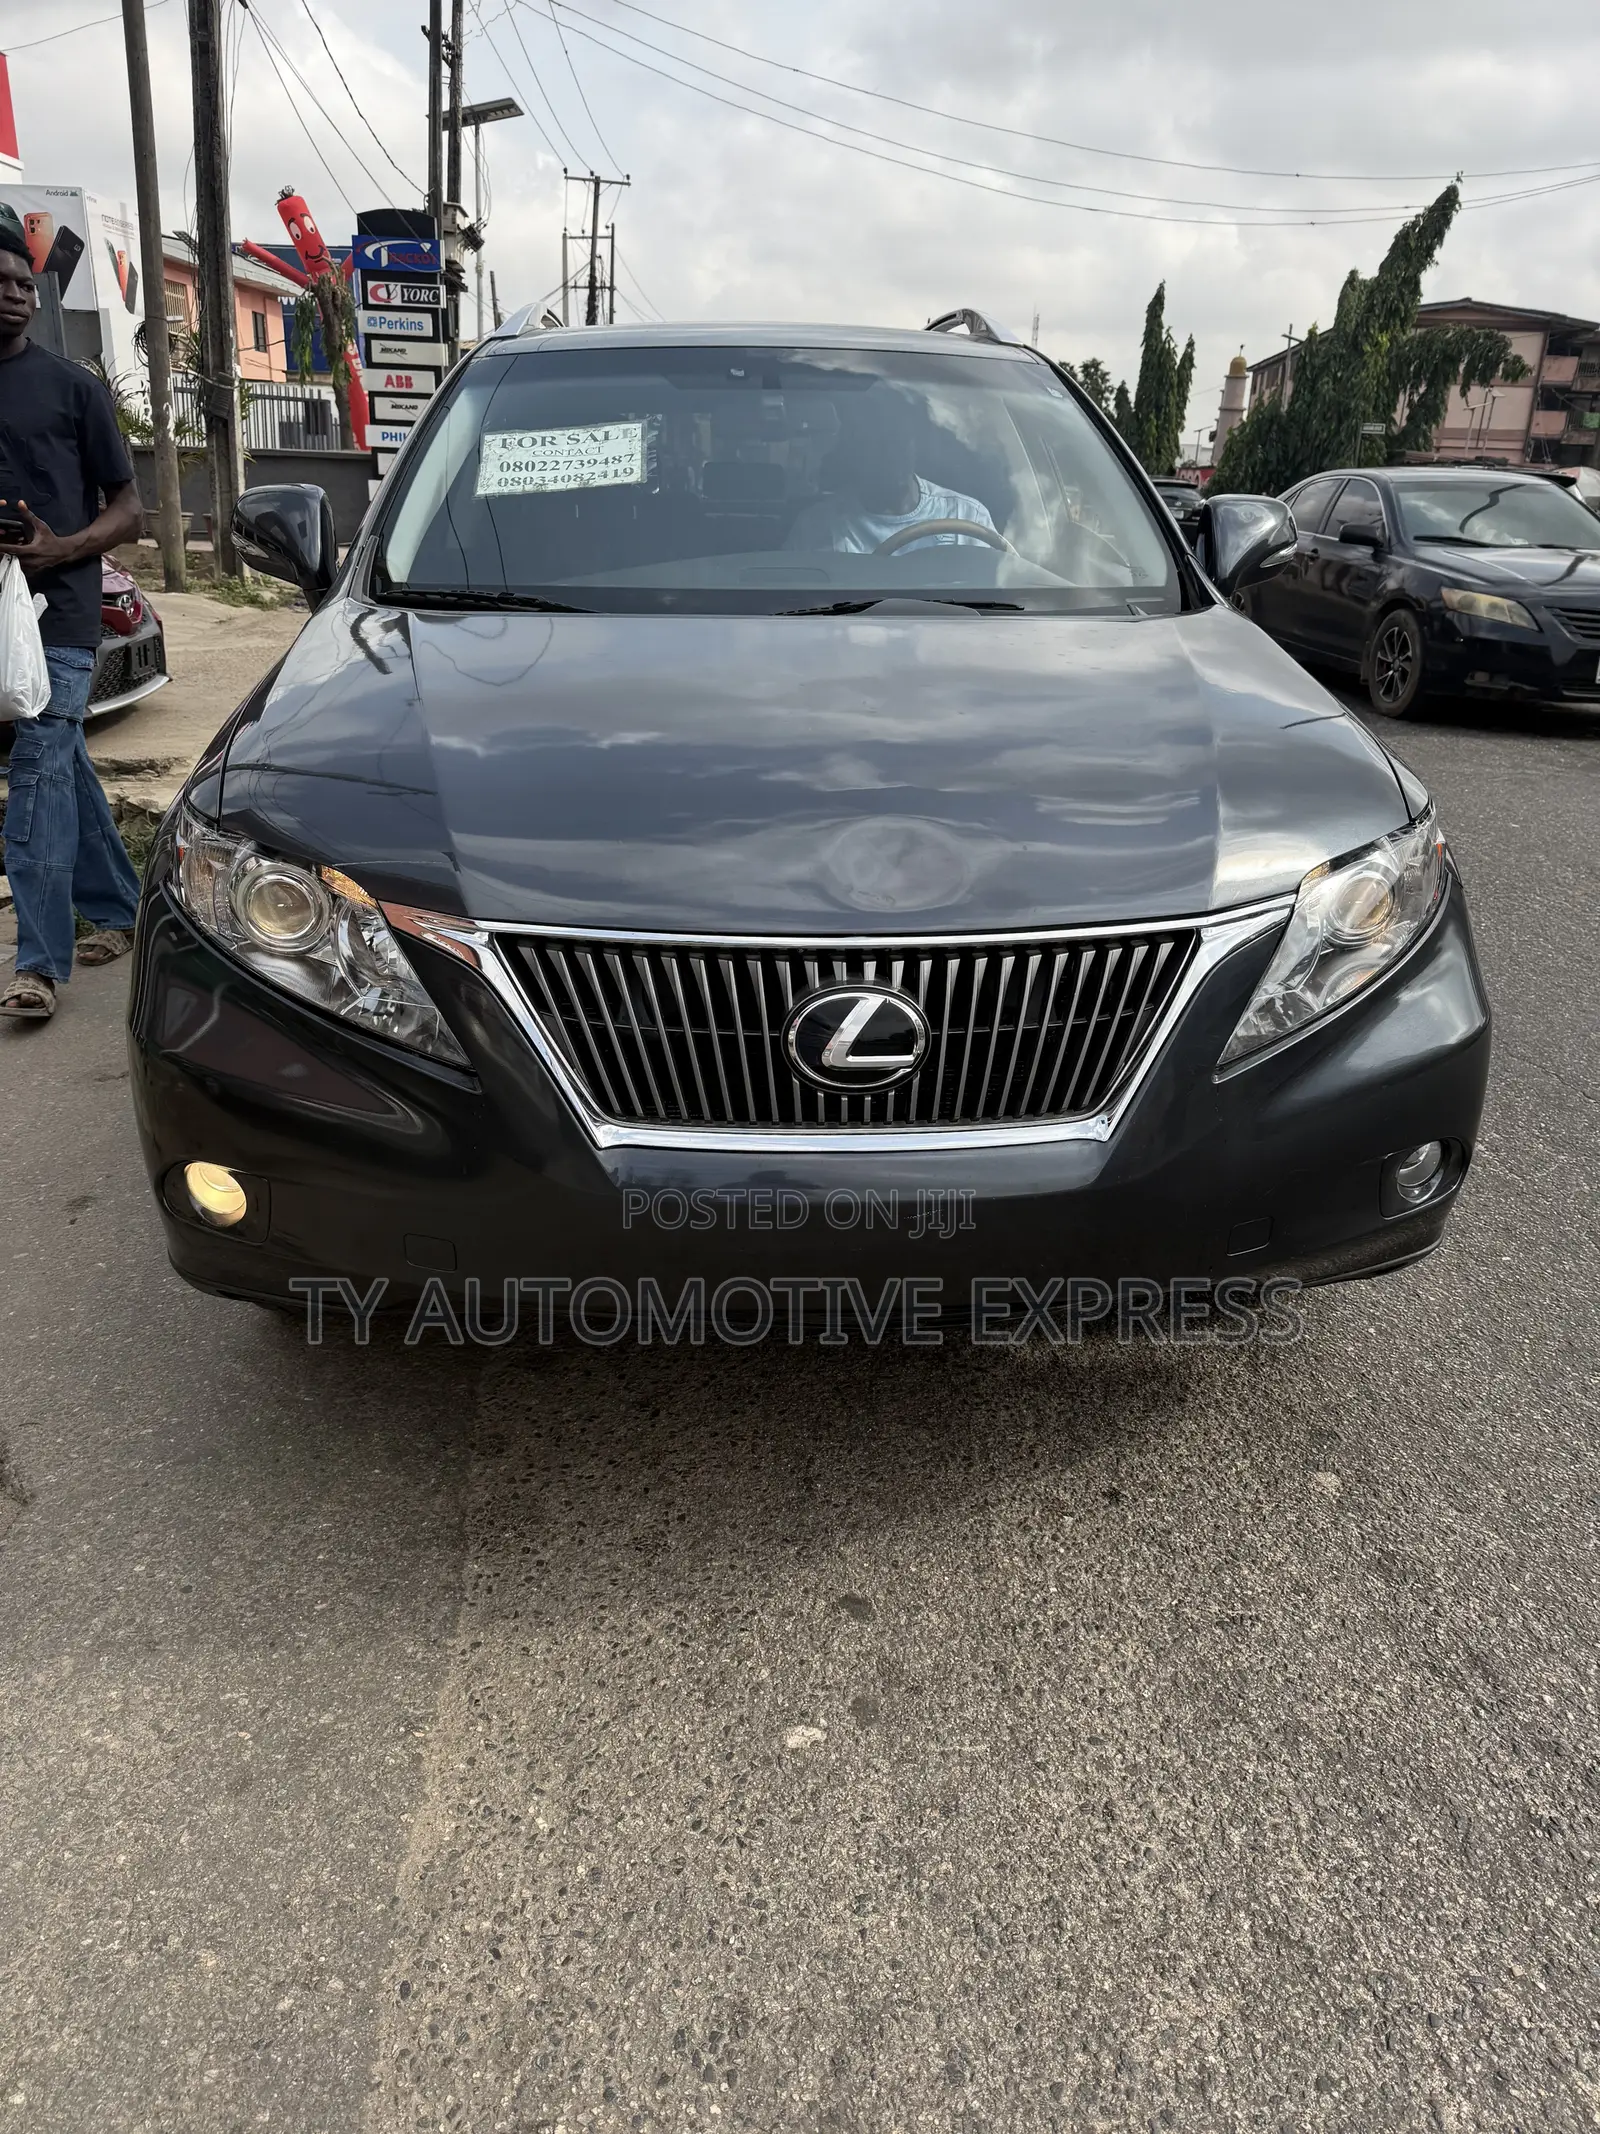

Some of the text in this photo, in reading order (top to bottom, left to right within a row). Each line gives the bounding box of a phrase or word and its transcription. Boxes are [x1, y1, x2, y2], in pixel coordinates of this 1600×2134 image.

[45, 189, 69, 197] Android
[402, 287, 439, 303] YORC
[378, 316, 424, 332] Perkins
[384, 374, 413, 389] ABB
[499, 427, 639, 450] FOR SALE
[531, 445, 605, 457] CONTACT
[499, 453, 635, 473] 08022739487
